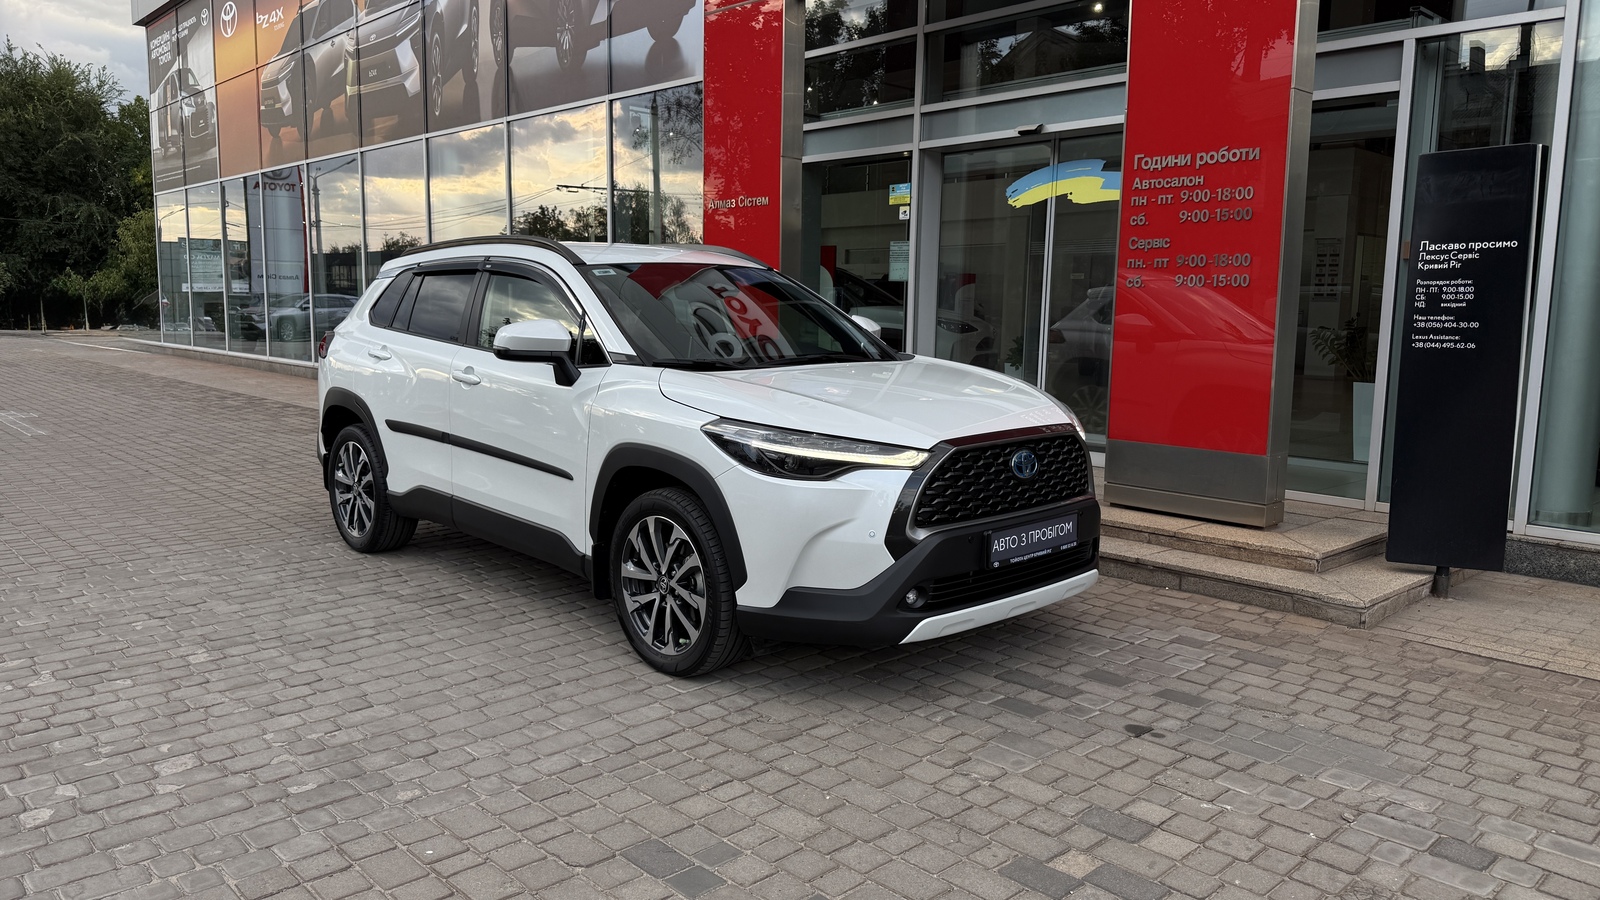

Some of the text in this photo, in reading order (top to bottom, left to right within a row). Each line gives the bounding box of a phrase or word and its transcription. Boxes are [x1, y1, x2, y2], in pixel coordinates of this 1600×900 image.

[1134, 146, 1261, 171] Години роботи
[1132, 175, 1204, 190] Автосалон
[709, 195, 769, 209] Алмаз Сістем
[1130, 213, 1149, 226] сб.
[1128, 237, 1171, 251] Сервіс
[1420, 240, 1518, 251] Ласкаво просимо
[1418, 251, 1480, 261] Лексус Сервіс
[1417, 260, 1462, 271] Кривий Ріг
[1126, 275, 1145, 288] сб.
[992, 535, 1018, 553] АВТО
[1028, 521, 1073, 544] ПРОБІГОМ
